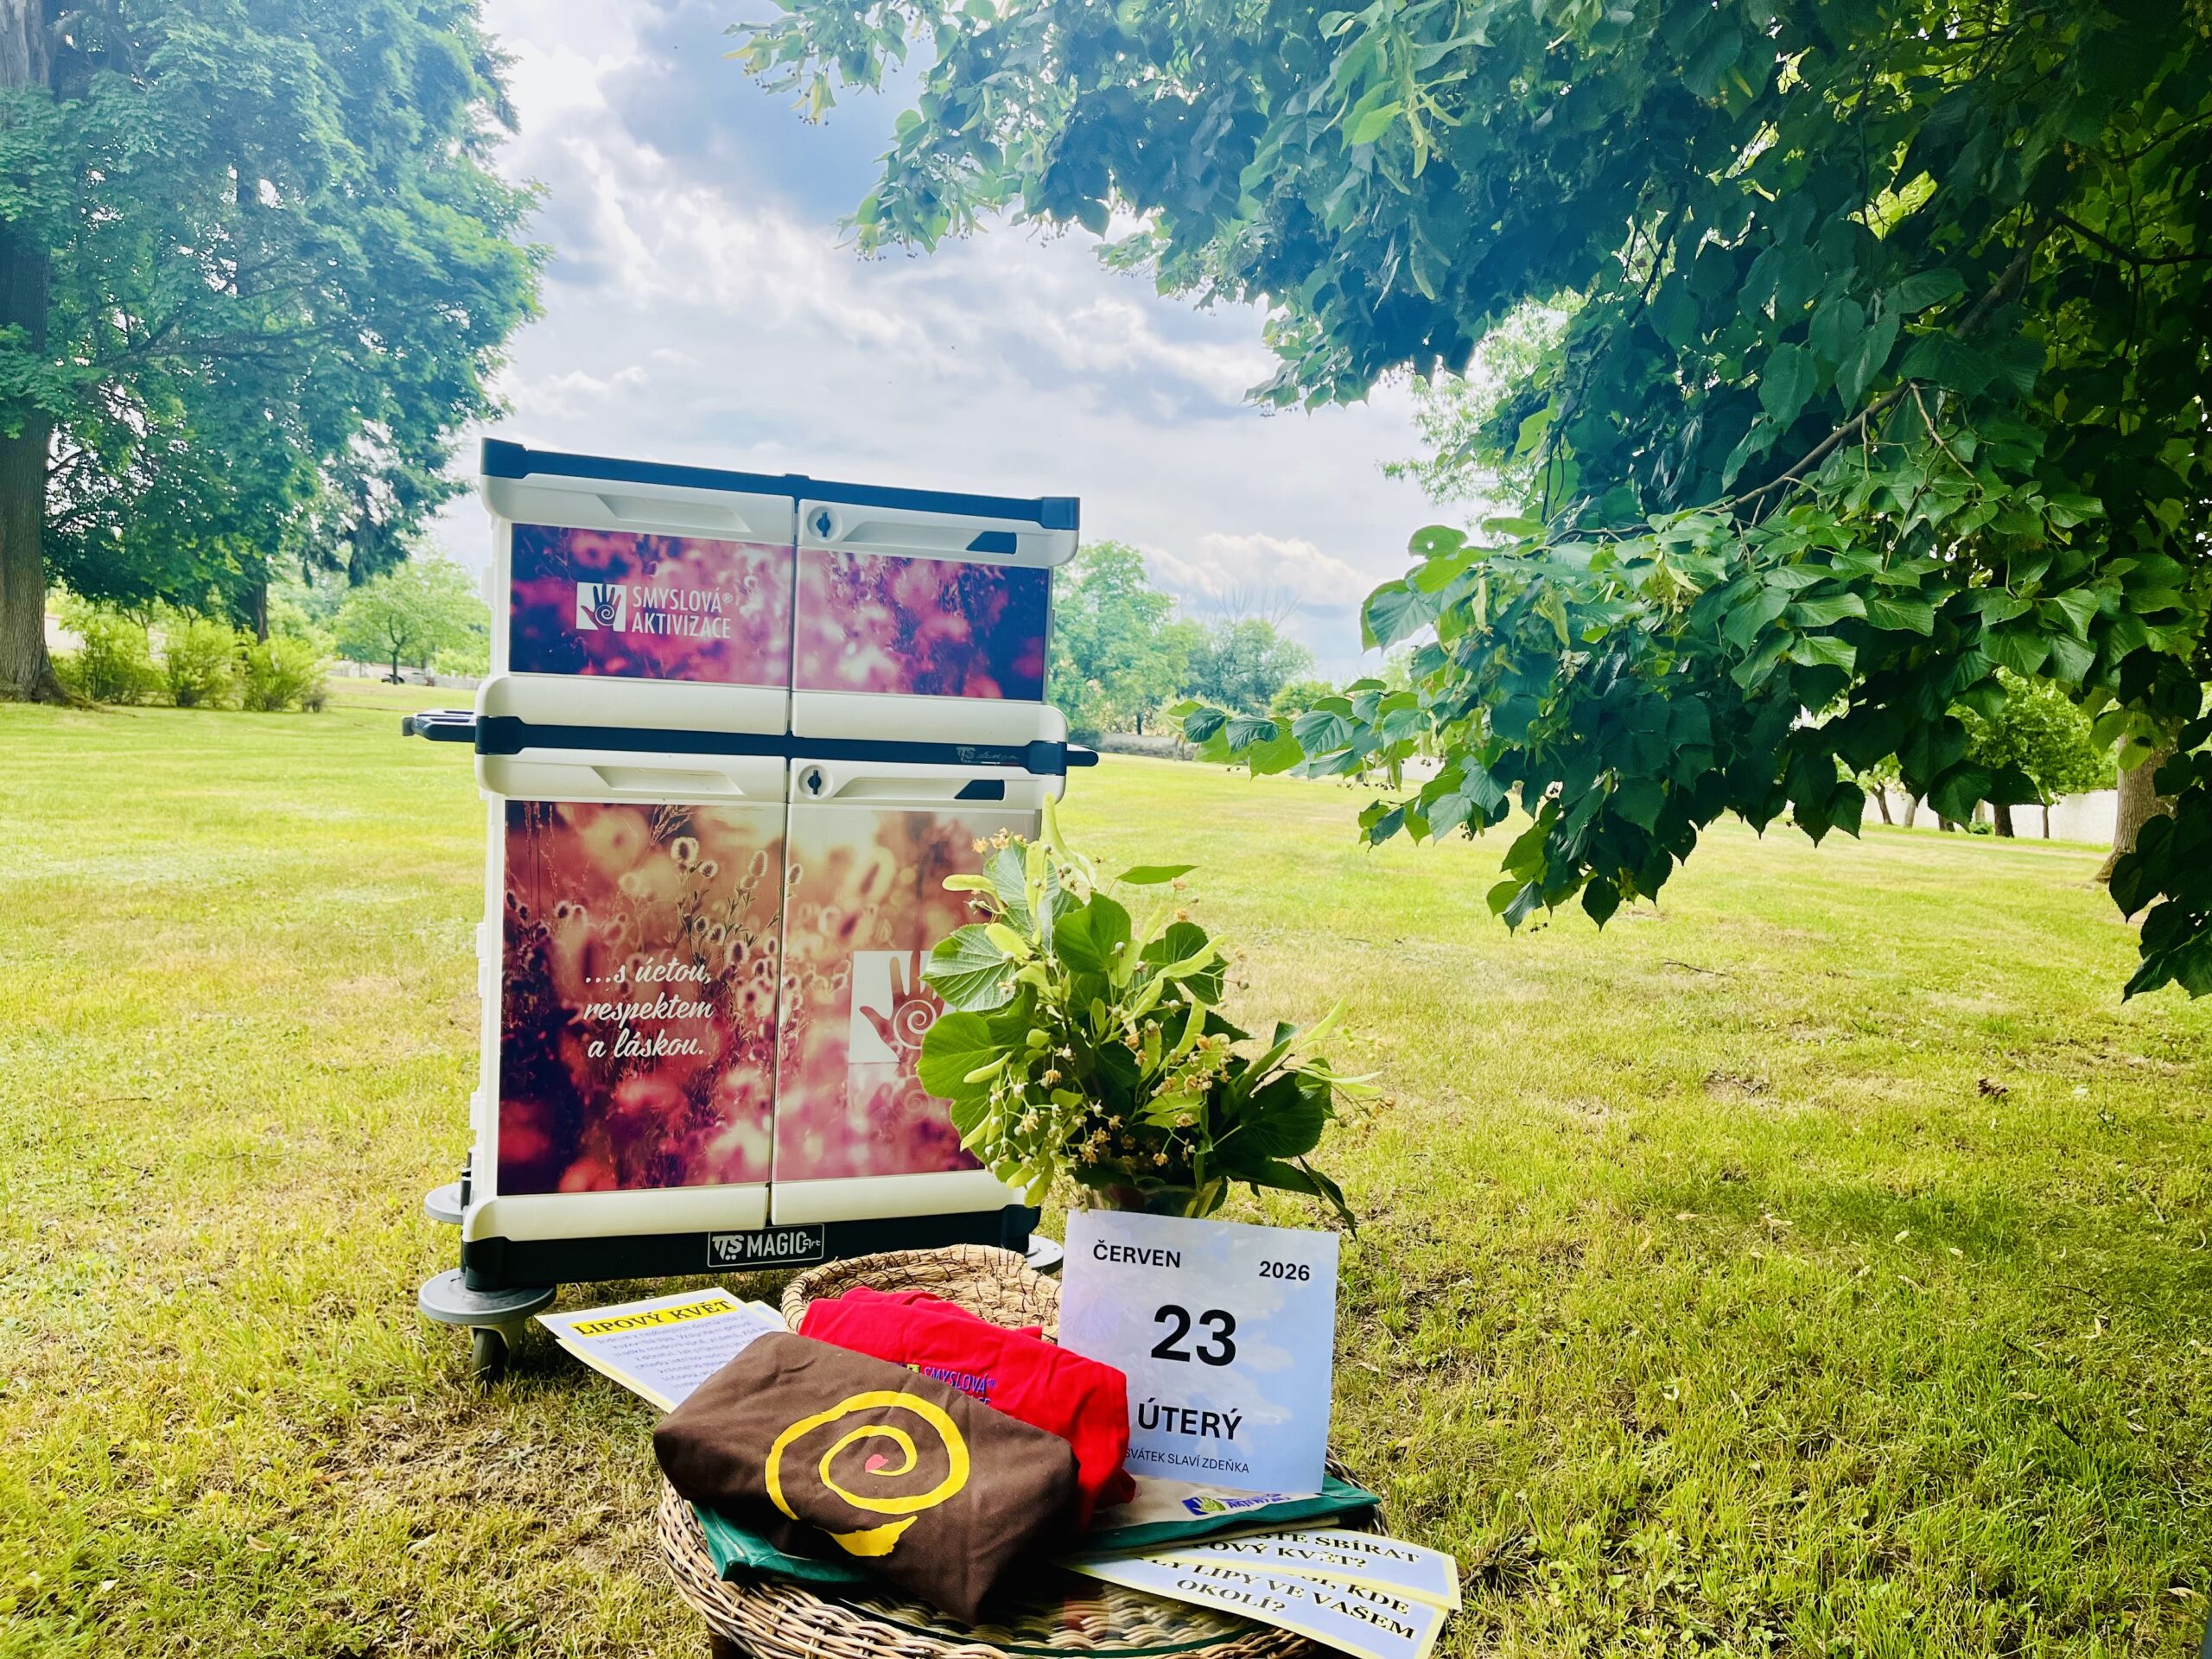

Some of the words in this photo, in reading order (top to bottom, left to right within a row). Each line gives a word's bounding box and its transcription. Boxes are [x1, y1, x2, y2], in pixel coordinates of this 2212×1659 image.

[631, 611, 732, 639] AKTIVIZACE
[582, 991, 715, 1030] respektem
[588, 1039, 607, 1058] a
[613, 1027, 705, 1058] láskou.
[1092, 1239, 1181, 1268] ČERVEN
[1258, 1260, 1311, 1281] 2026
[572, 1311, 664, 1337] LIPOVÝ
[666, 1300, 734, 1319] KVĚT
[1150, 1304, 1236, 1367] 23
[1137, 1396, 1243, 1440] ÚTERÝ
[1167, 1452, 1200, 1467] SLAVÍ
[1201, 1457, 1250, 1473] ZDEŇKA
[1193, 1538, 1268, 1554] OVÝ
[1276, 1547, 1367, 1567] KVĚT?
[1314, 1535, 1420, 1563] SBÍRAT
[1176, 1579, 1286, 1612] OKOLÍ?
[1192, 1564, 1261, 1585] LIPY
[1267, 1579, 1306, 1599] VE
[1313, 1591, 1418, 1640] VAŠEM
[1346, 1583, 1410, 1615] KDE
